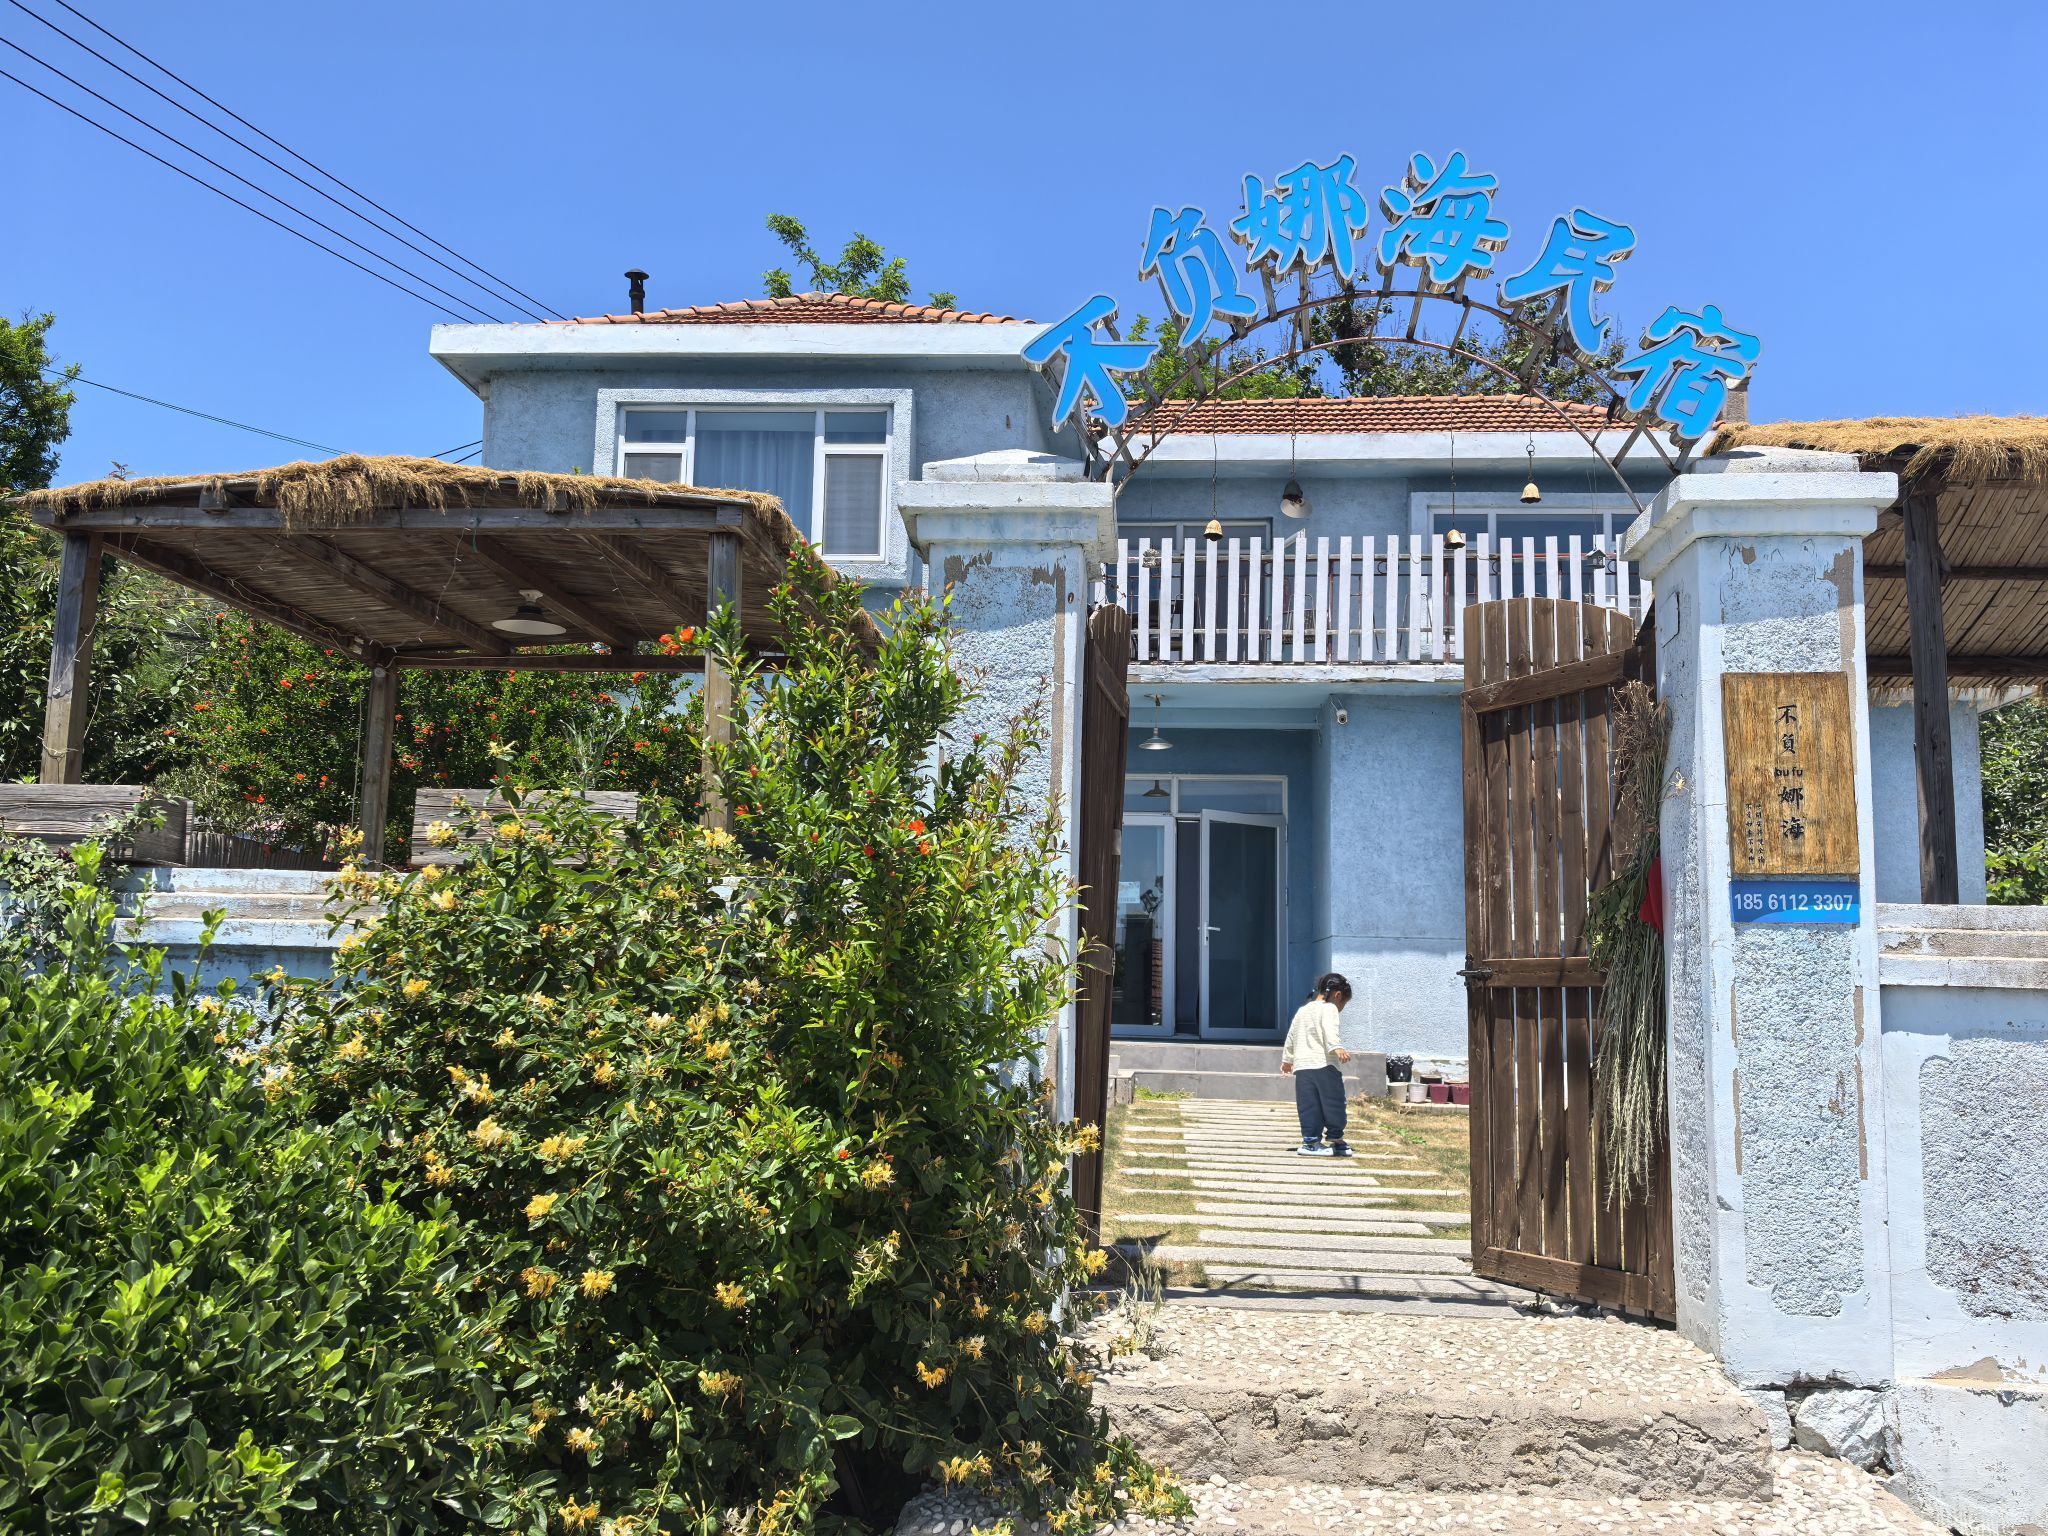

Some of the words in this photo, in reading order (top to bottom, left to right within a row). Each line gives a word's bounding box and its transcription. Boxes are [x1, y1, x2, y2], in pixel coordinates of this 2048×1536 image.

[1792, 766, 1803, 777] fu
[1734, 893, 1763, 910] 185
[1768, 893, 1809, 911] 6112
[1813, 894, 1854, 911] 3307
